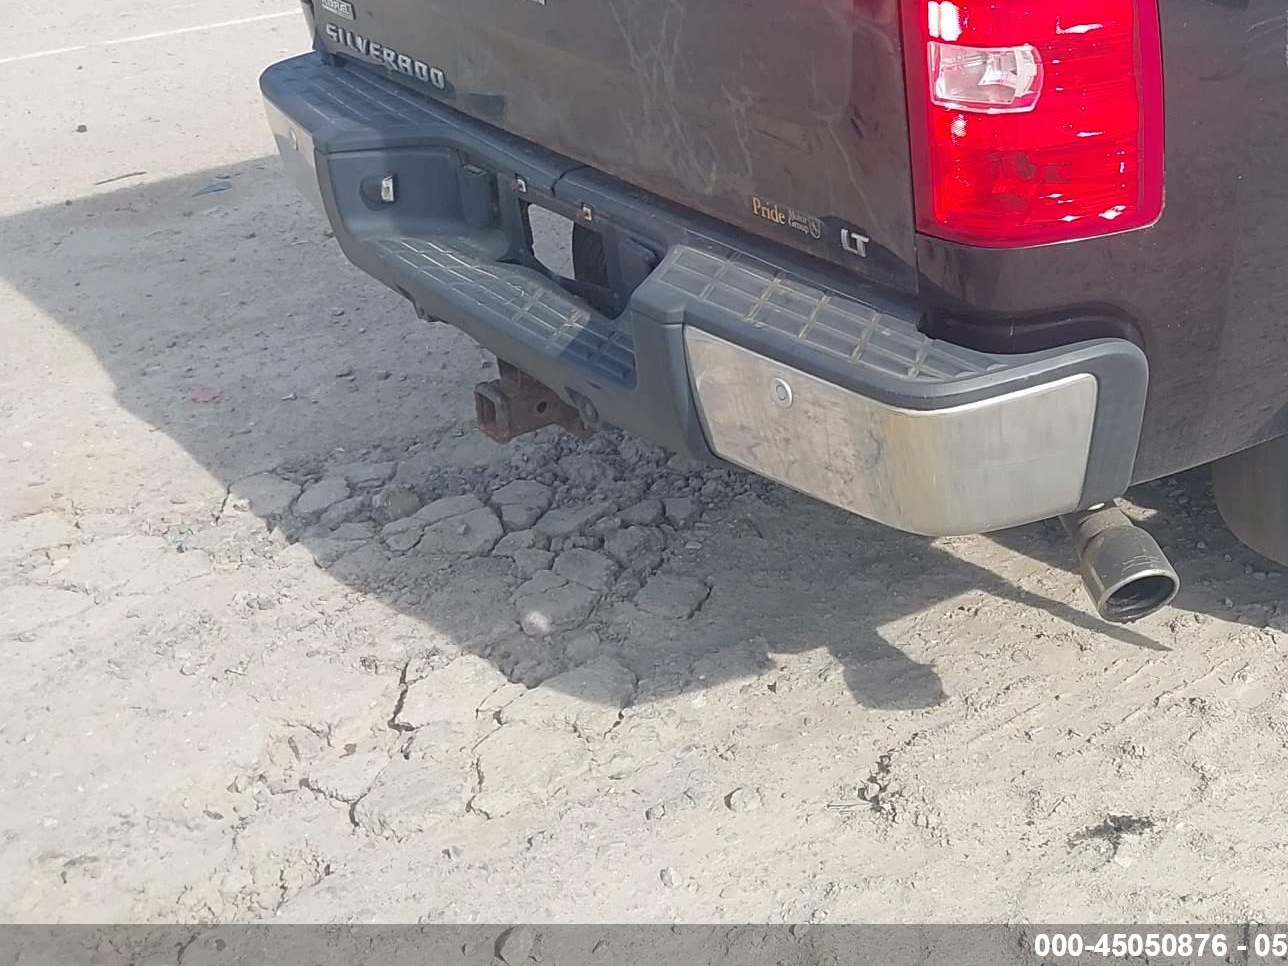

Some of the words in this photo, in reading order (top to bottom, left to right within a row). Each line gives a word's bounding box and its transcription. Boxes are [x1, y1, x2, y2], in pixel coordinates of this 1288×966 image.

[325, 22, 446, 90] SILVERADO
[752, 196, 786, 225] Pride
[840, 228, 870, 258] LT
